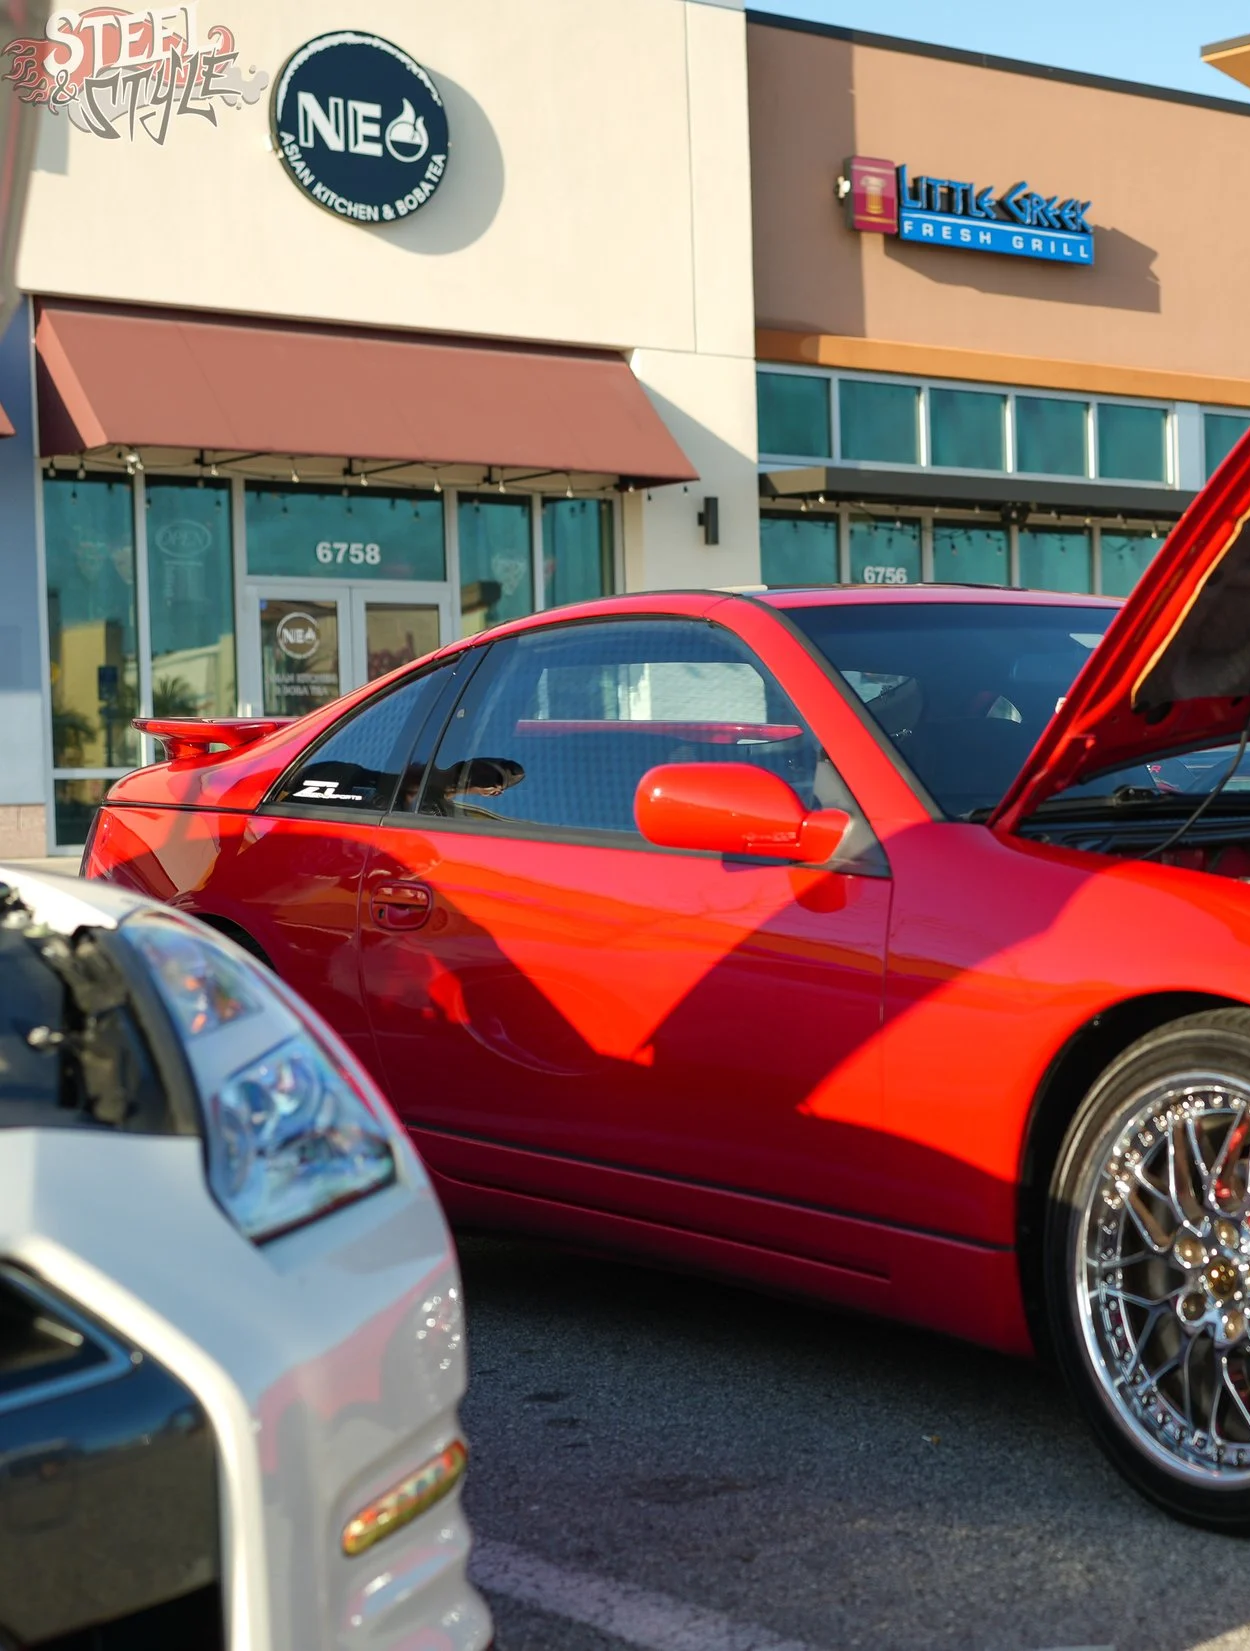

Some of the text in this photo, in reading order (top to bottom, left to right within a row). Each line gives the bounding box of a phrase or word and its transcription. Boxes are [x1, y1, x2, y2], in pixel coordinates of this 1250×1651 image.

[280, 130, 447, 222] ASIAN KITCHEN & BOBA TEA
[903, 220, 1090, 259] FRESH GRILL
[315, 541, 382, 565] 6758
[863, 565, 907, 584] 6756
